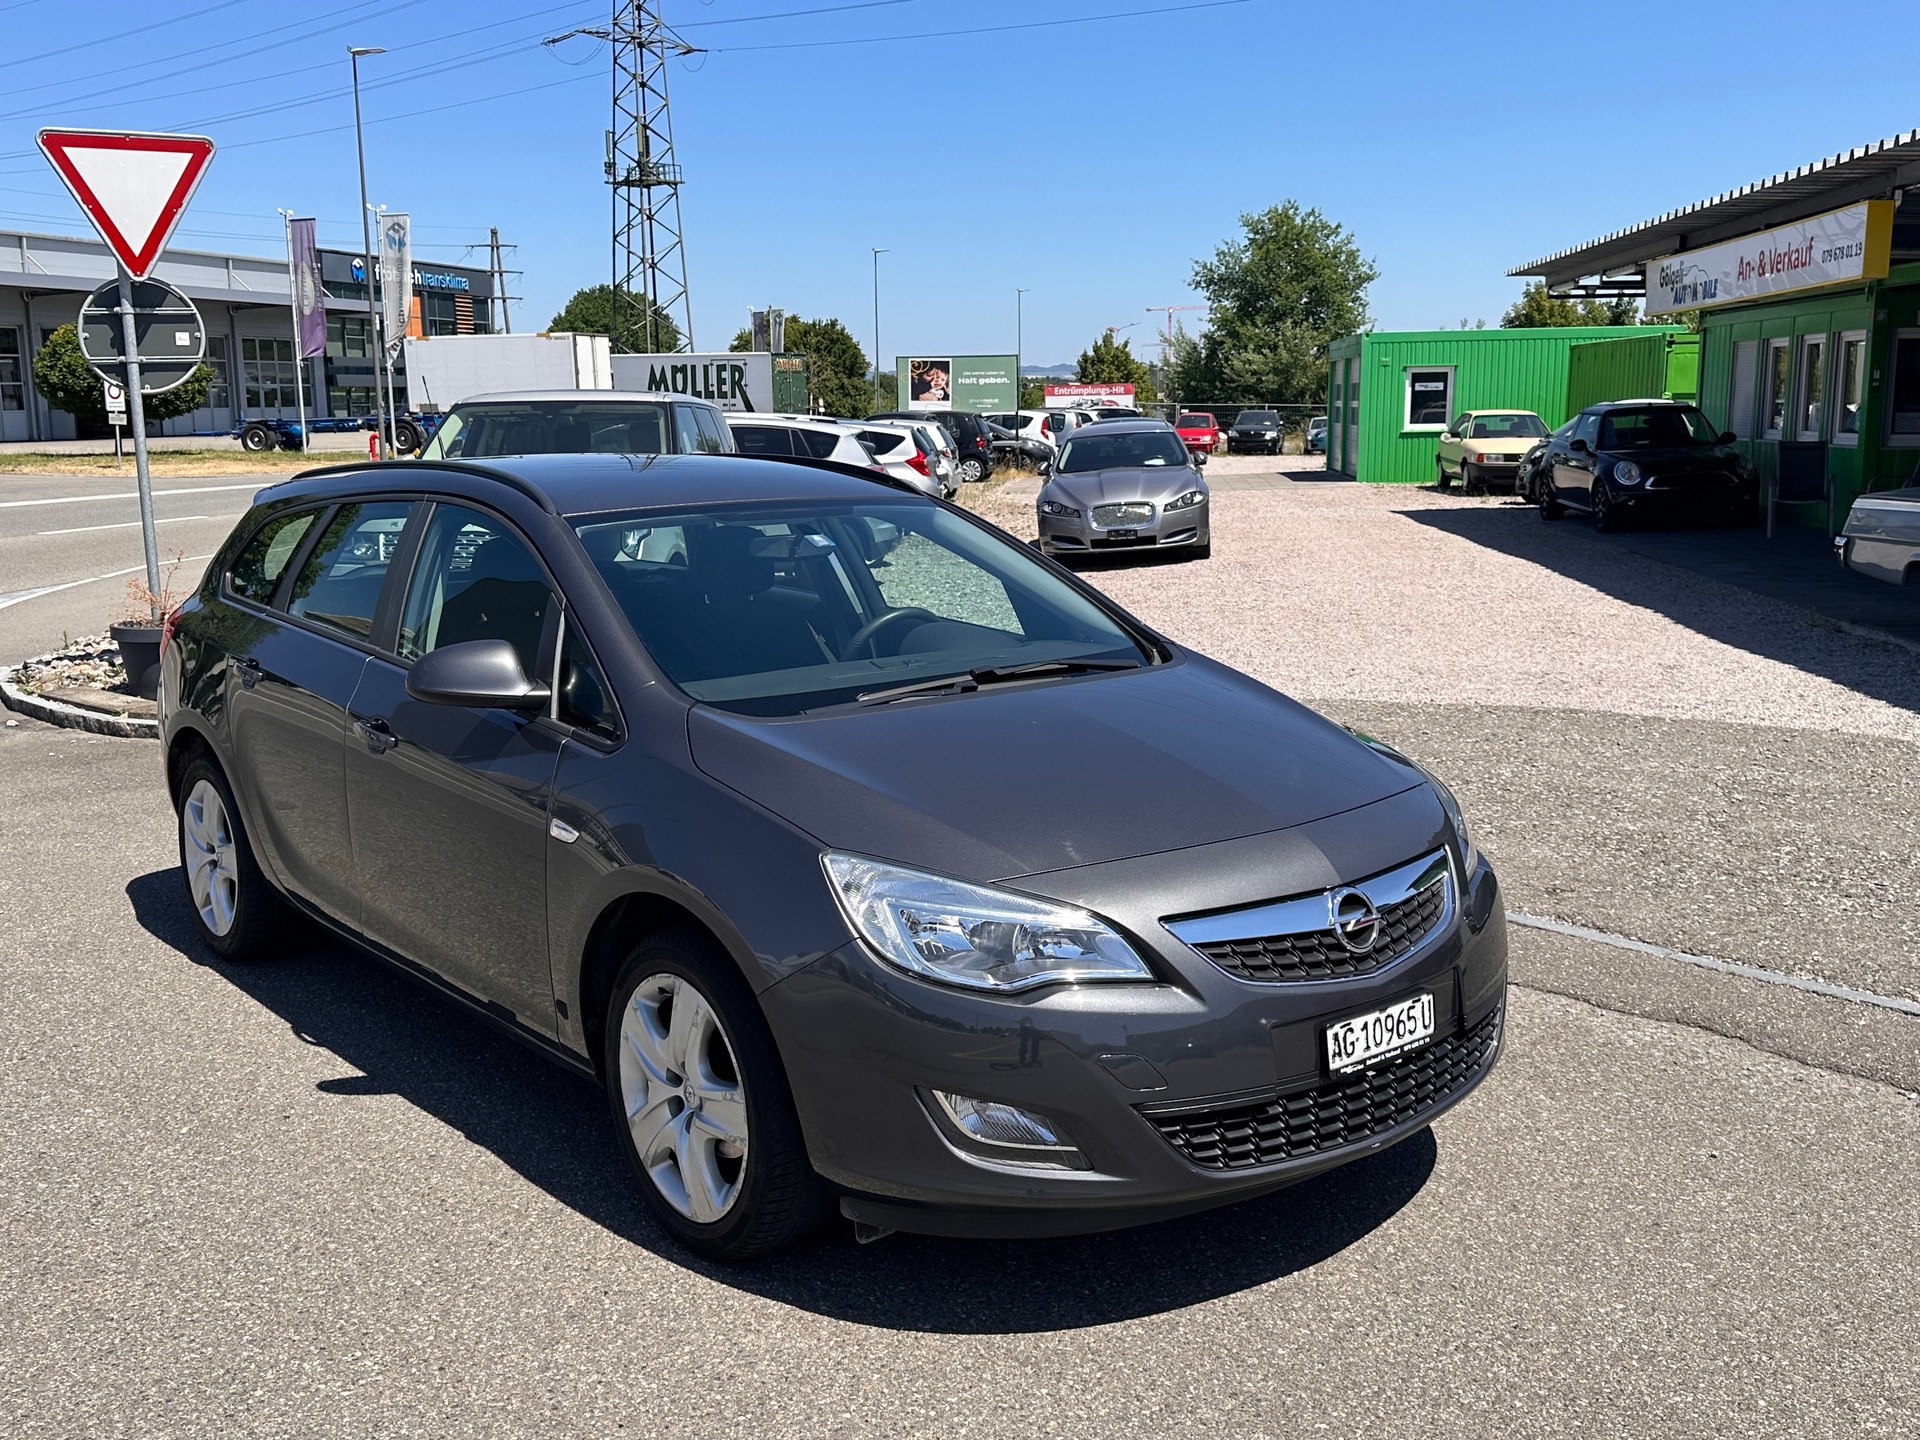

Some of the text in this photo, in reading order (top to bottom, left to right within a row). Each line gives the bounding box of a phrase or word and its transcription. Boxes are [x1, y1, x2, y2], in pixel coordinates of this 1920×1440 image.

[1737, 236, 1863, 281] An- & Verkauf 079 678 01 19
[648, 363, 755, 412] MÜLLER
[978, 377, 1010, 385] geben.
